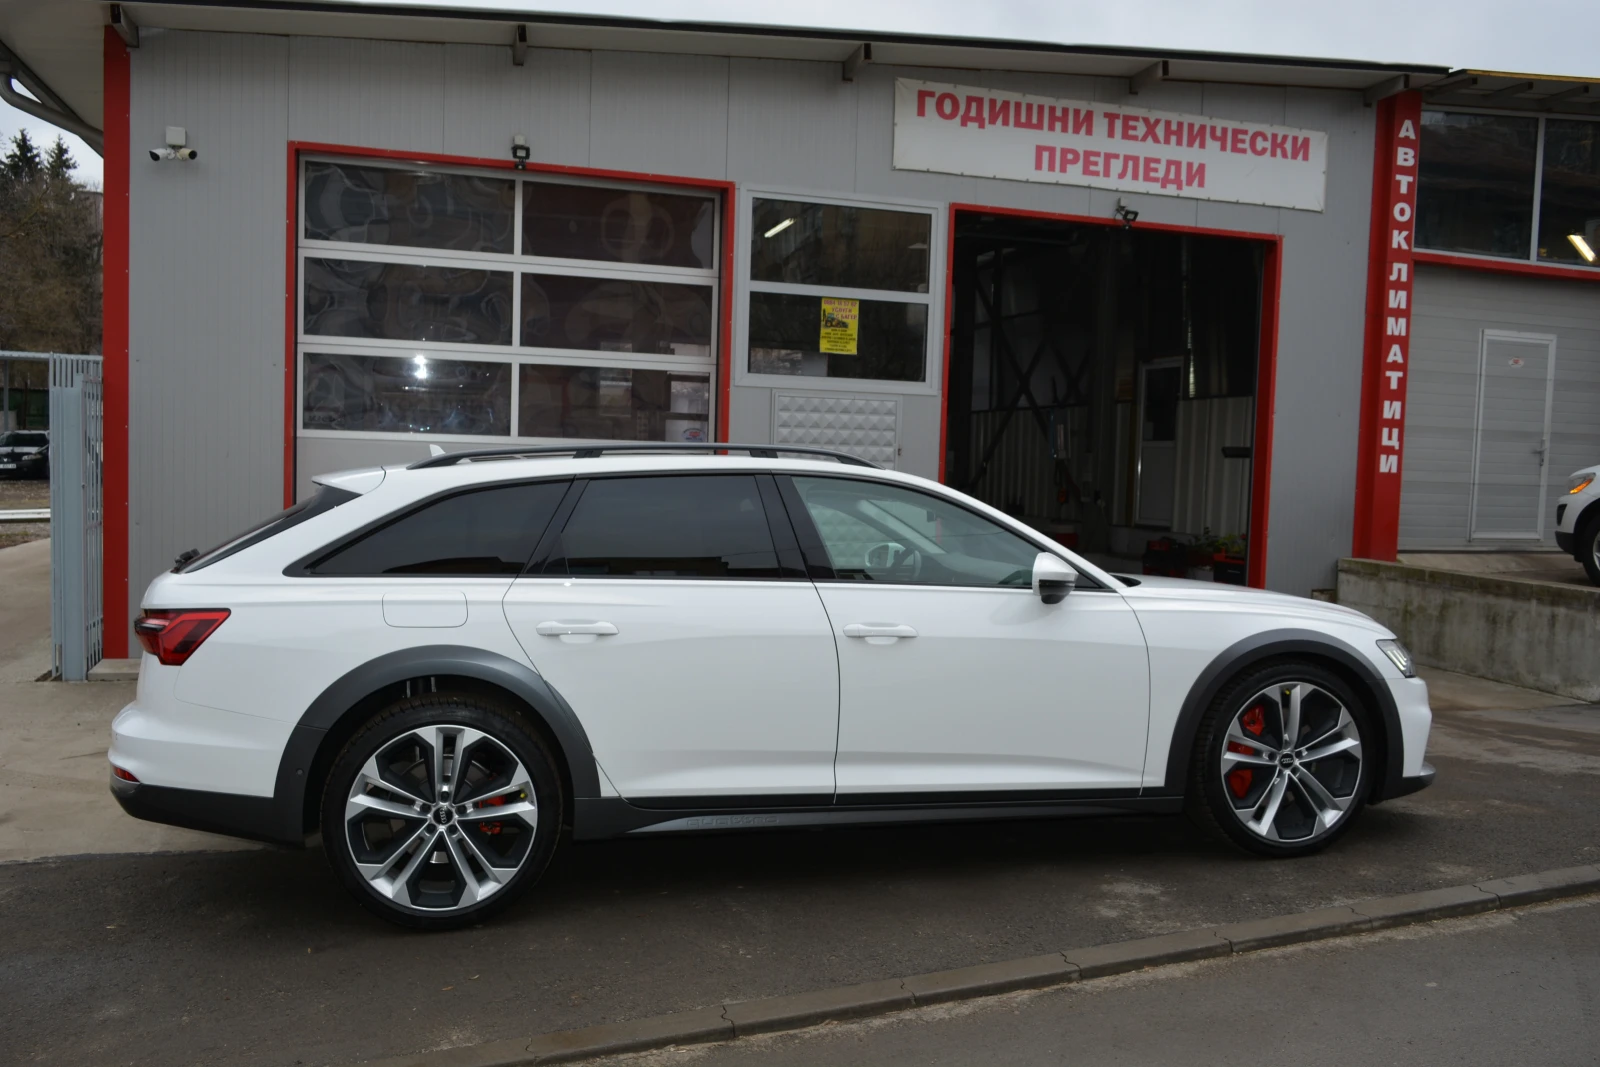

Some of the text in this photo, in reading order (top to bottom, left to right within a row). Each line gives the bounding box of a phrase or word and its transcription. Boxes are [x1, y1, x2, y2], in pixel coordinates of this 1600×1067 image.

[917, 90, 1311, 161] ГОДИШНИ ТЕХНИЧЕСКИ
[1034, 145, 1206, 190] ПРЕГЛЕДИ
[1379, 119, 1415, 474] АВТОКЛИМАТИЦИ
